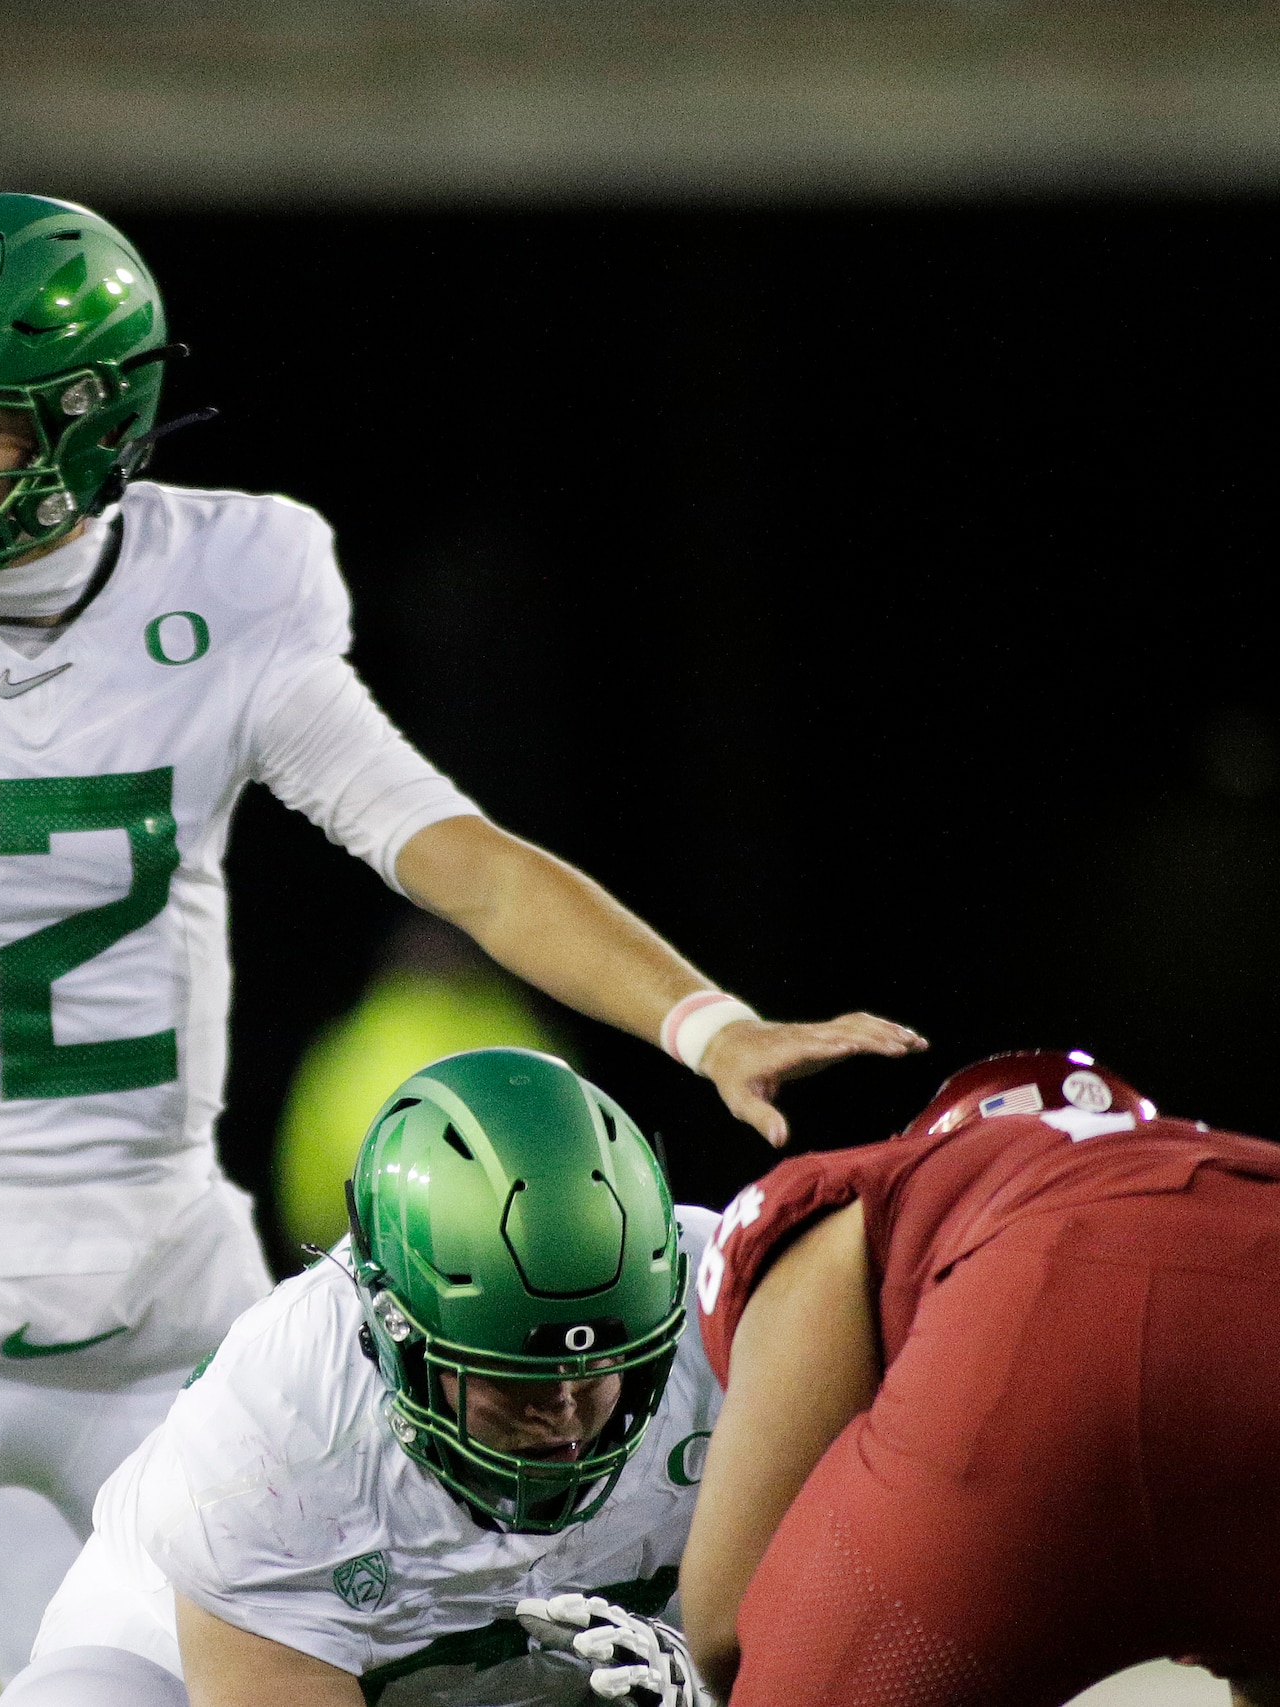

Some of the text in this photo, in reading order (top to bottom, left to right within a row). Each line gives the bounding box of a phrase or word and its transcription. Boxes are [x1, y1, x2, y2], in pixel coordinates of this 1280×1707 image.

[144, 611, 209, 665] O
[565, 1325, 595, 1351] O
[351, 1580, 381, 1605] 12
